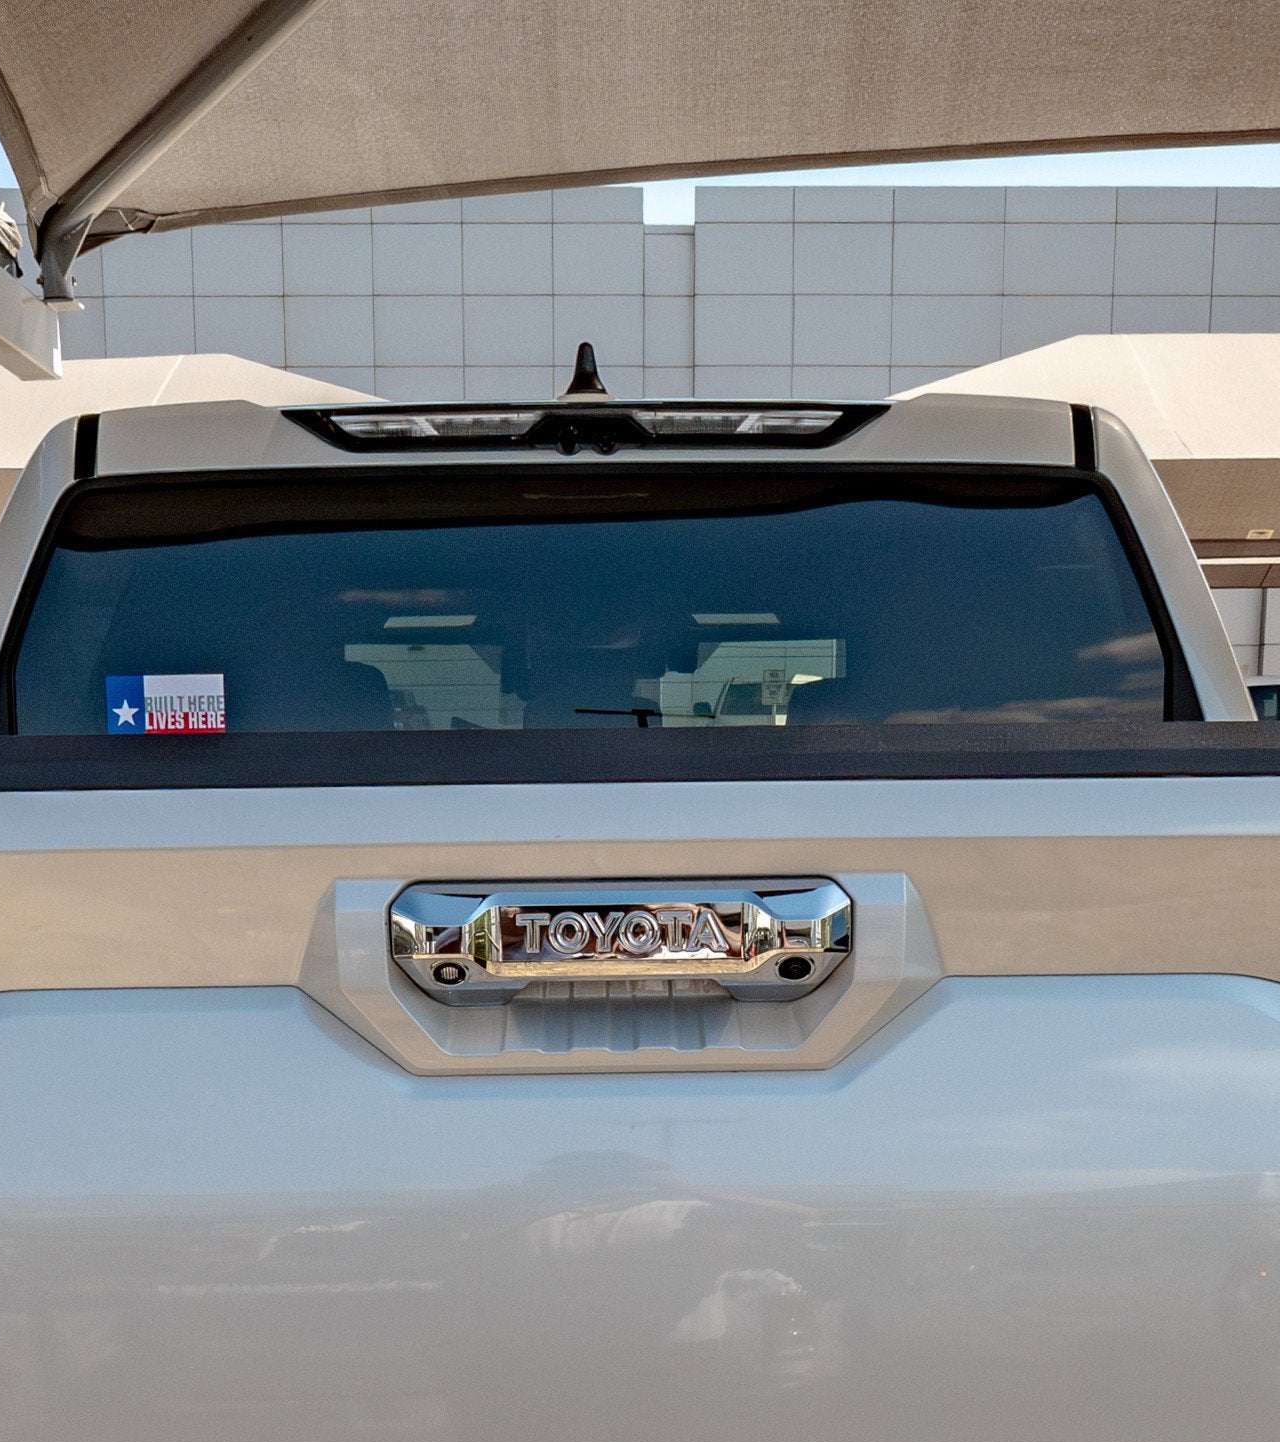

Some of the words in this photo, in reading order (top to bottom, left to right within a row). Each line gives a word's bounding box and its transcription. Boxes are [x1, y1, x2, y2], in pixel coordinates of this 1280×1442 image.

[145, 696, 184, 712] BUILT
[188, 695, 224, 712] HERE
[145, 711, 184, 730] LIVES
[188, 710, 225, 729] HERE
[516, 910, 730, 954] TOYOTA
